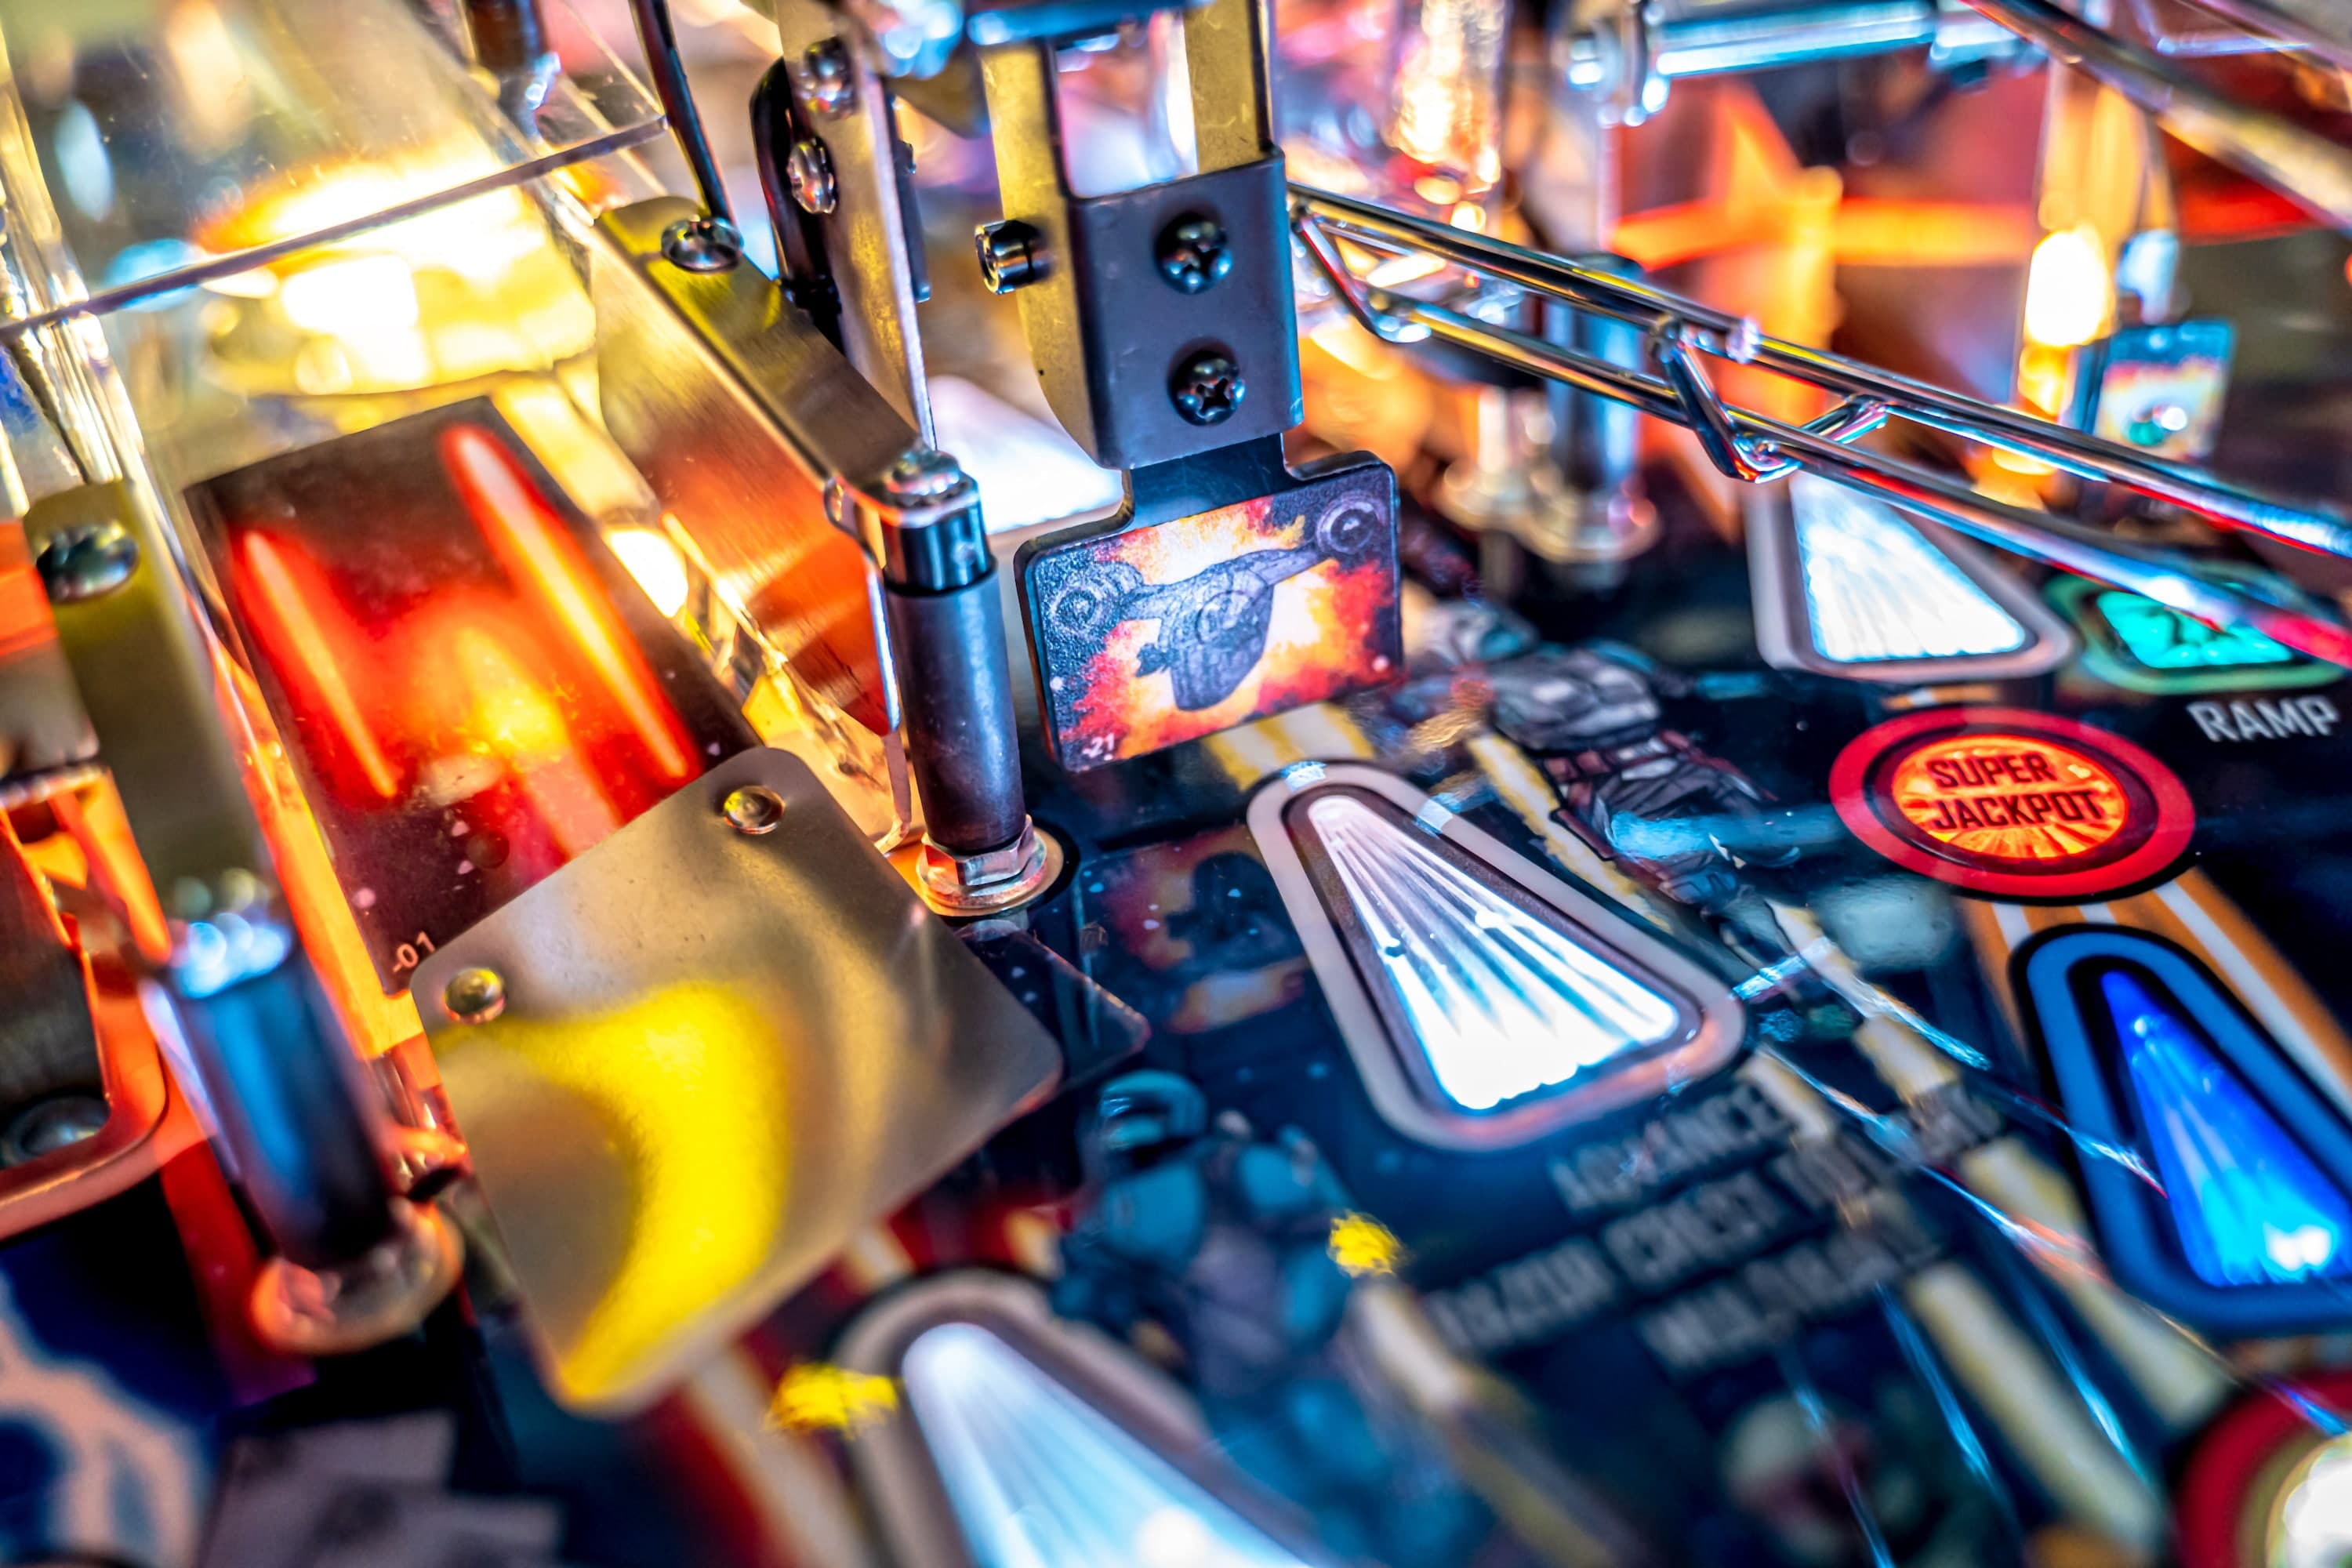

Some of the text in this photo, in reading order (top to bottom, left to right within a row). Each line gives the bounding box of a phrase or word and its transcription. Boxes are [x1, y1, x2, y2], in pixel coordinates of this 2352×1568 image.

[2186, 695, 2339, 742] RAMP
[1926, 750, 2058, 789] SUPER
[1931, 789, 2109, 830] JACKPOT
